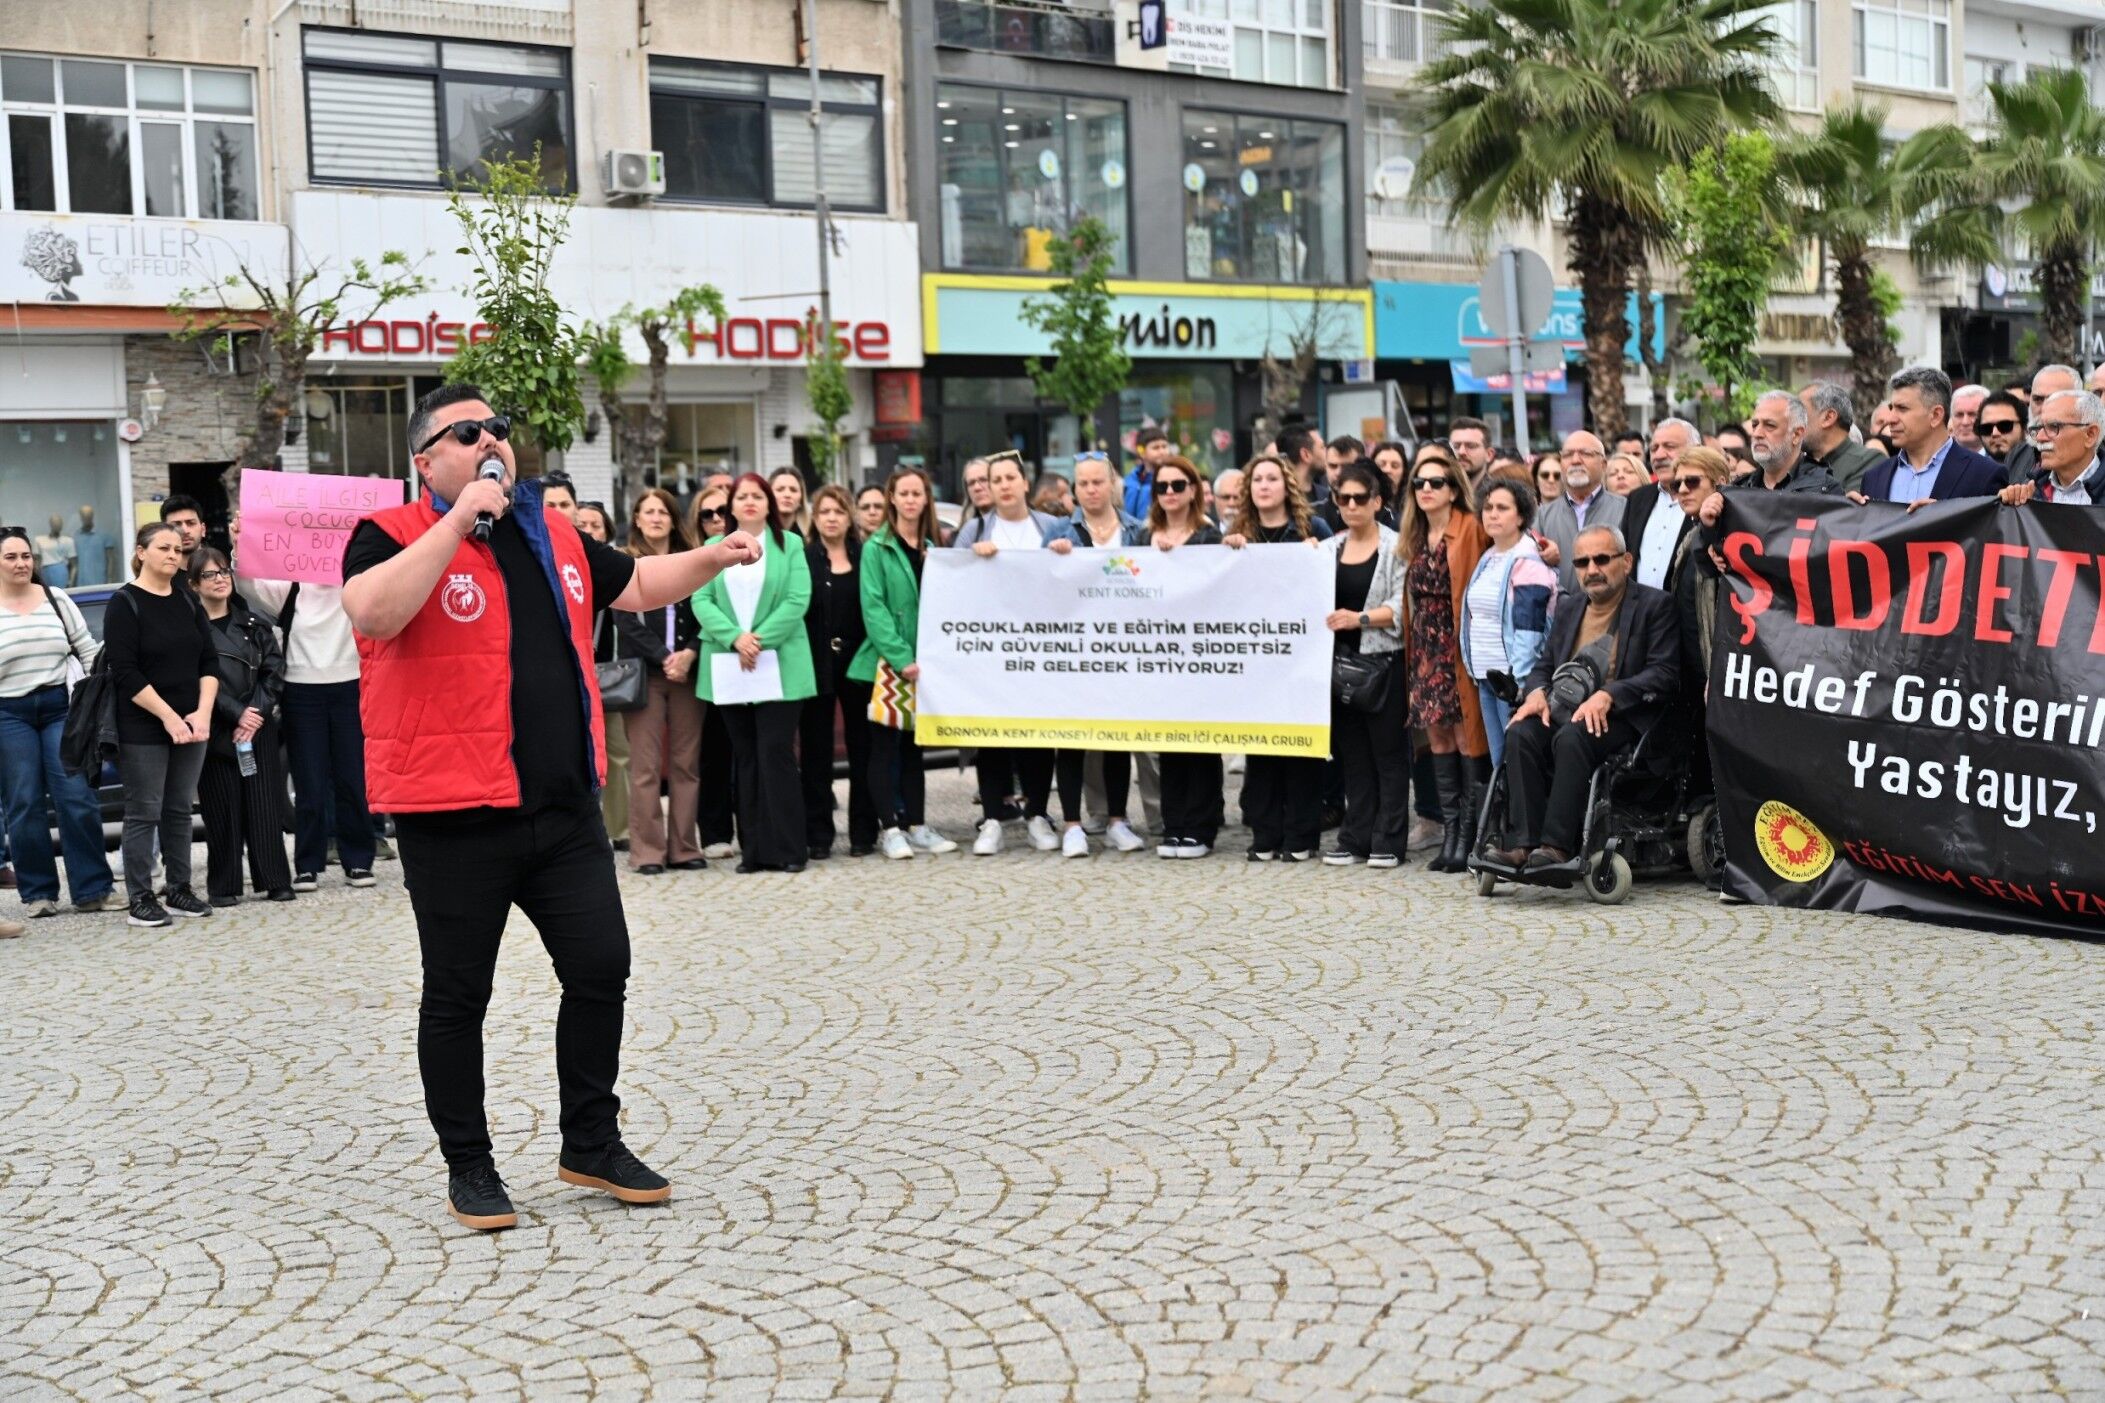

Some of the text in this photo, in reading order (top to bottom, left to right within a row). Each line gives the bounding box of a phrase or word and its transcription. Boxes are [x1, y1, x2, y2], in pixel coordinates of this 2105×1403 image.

[98, 257, 192, 277] COIFFEUR
[284, 511, 362, 530] ÇOCUĞ
[264, 533, 292, 551] EN
[1078, 586, 1111, 598] KENT
[941, 618, 1307, 638] ÇOCUKLARIMIZ VE EĞİTİM EMEKÇİLERİ
[955, 637, 1292, 657] İÇİN GÜVENLİ OKULLAR, ŞİDDETSİZ
[1005, 657, 1244, 674] BİR GELECEK İSTİYORUZ!
[1724, 652, 1877, 716] Hedef
[936, 726, 1313, 748] BORNOVA KENT KONSEYİ OKUL AİLE BİRLİĞİ ÇALIŞMA GRUBU
[1847, 740, 2097, 834] Yastayız,
[1843, 839, 1965, 890] EĞİTİM
[1969, 875, 2044, 908] SEN
